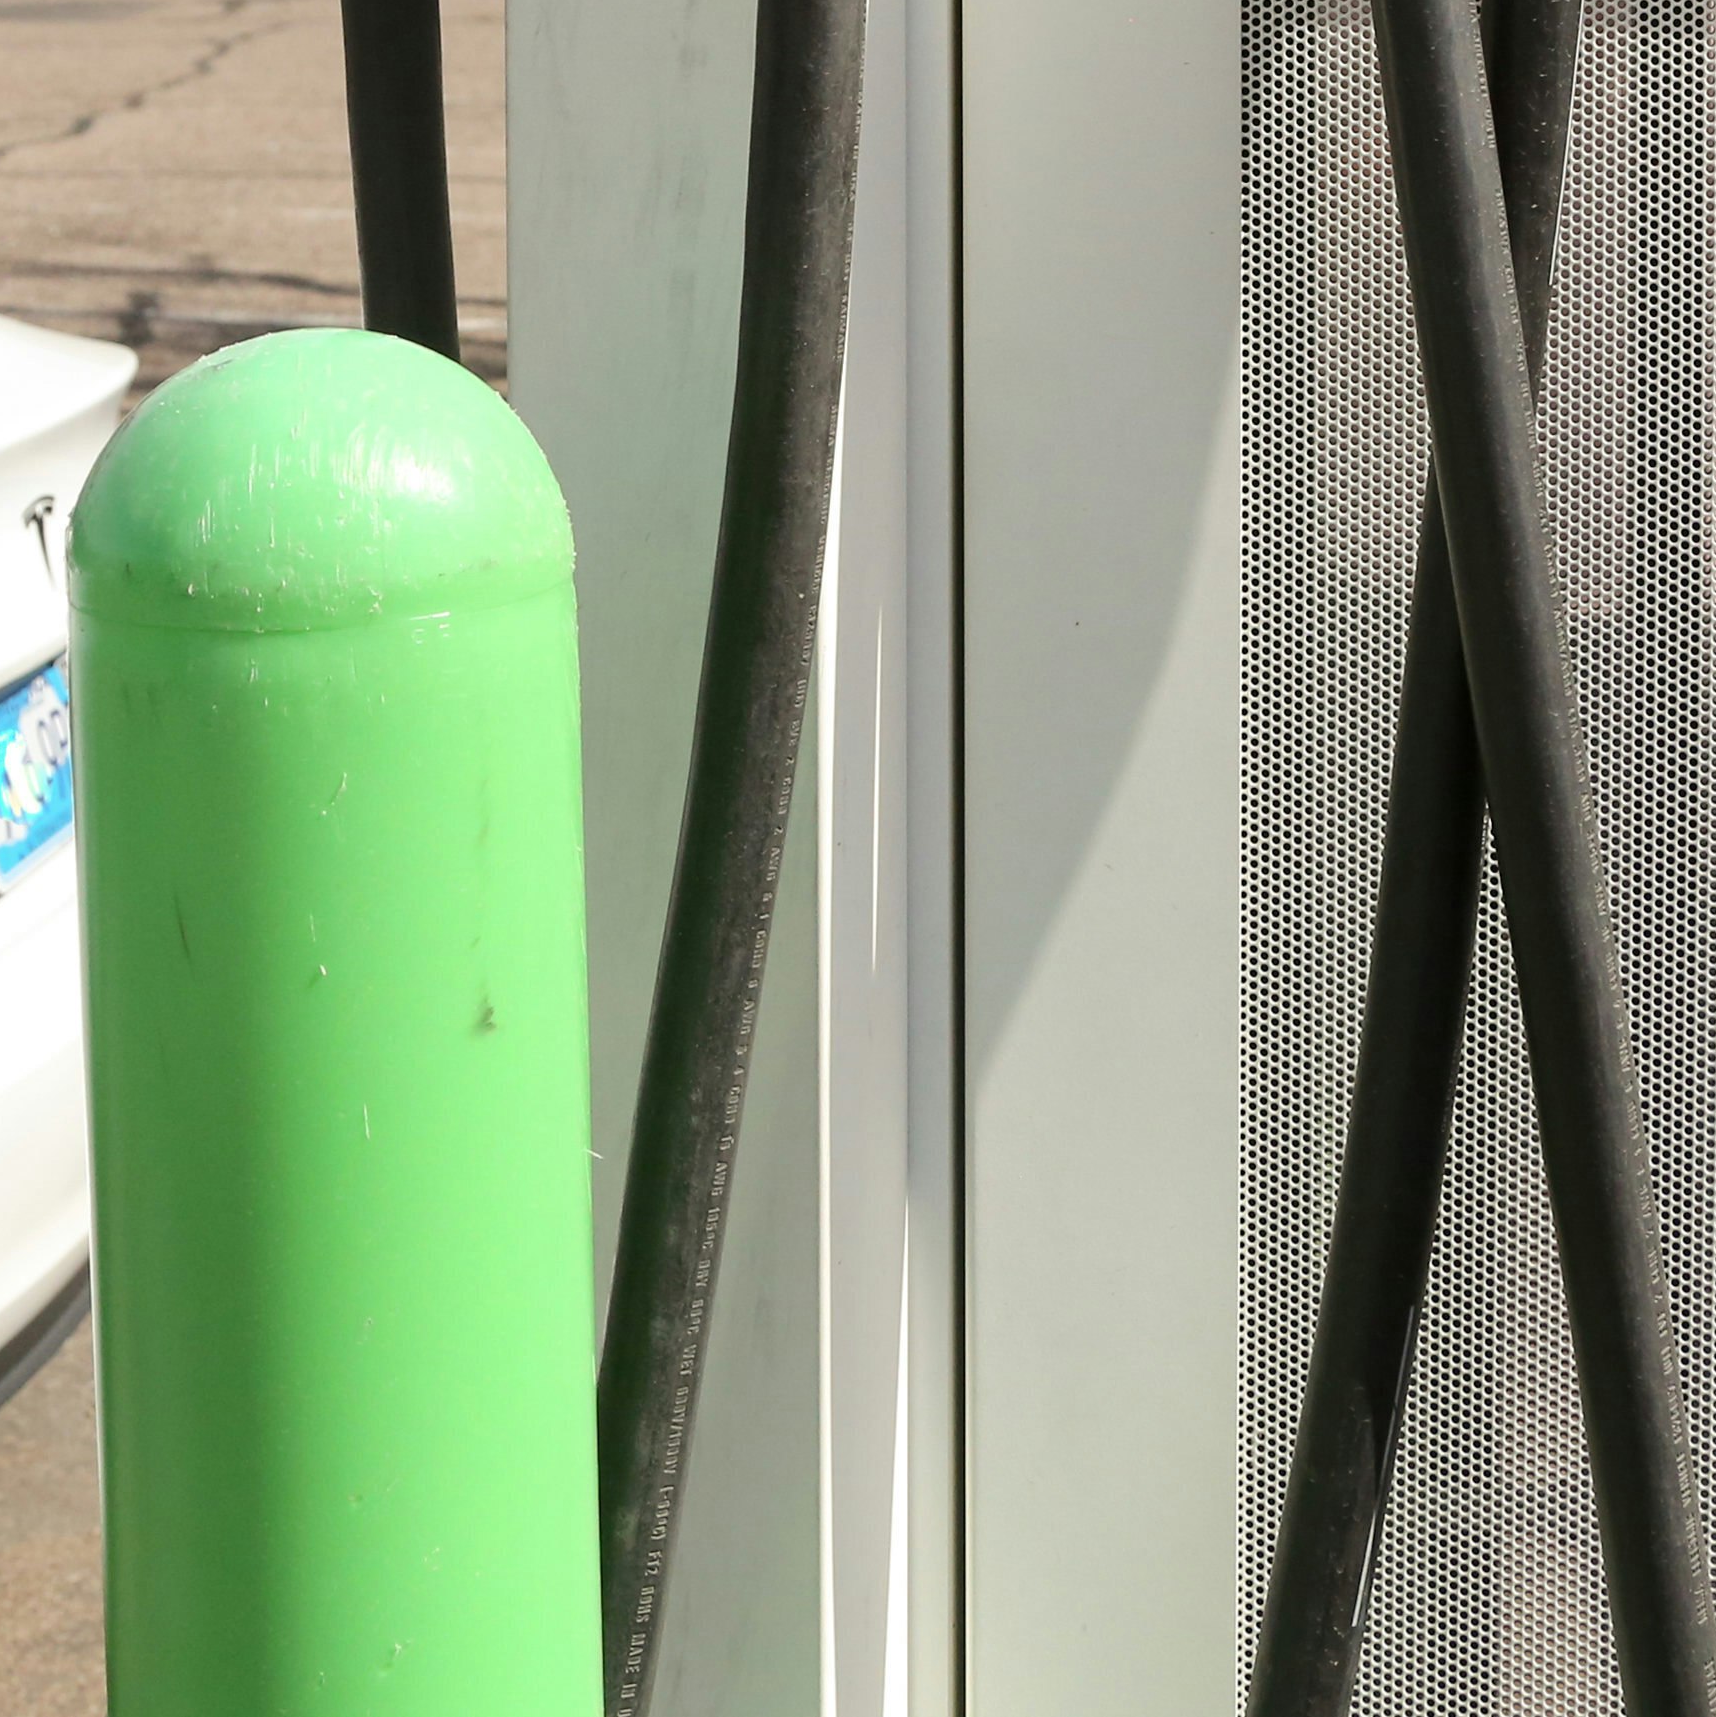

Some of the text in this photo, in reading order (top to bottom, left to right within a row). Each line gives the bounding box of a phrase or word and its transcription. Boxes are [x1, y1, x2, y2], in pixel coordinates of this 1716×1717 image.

[710, 1160, 728, 1196] AWG
[679, 1343, 697, 1375] WET
[625, 1631, 647, 1673] MADE
